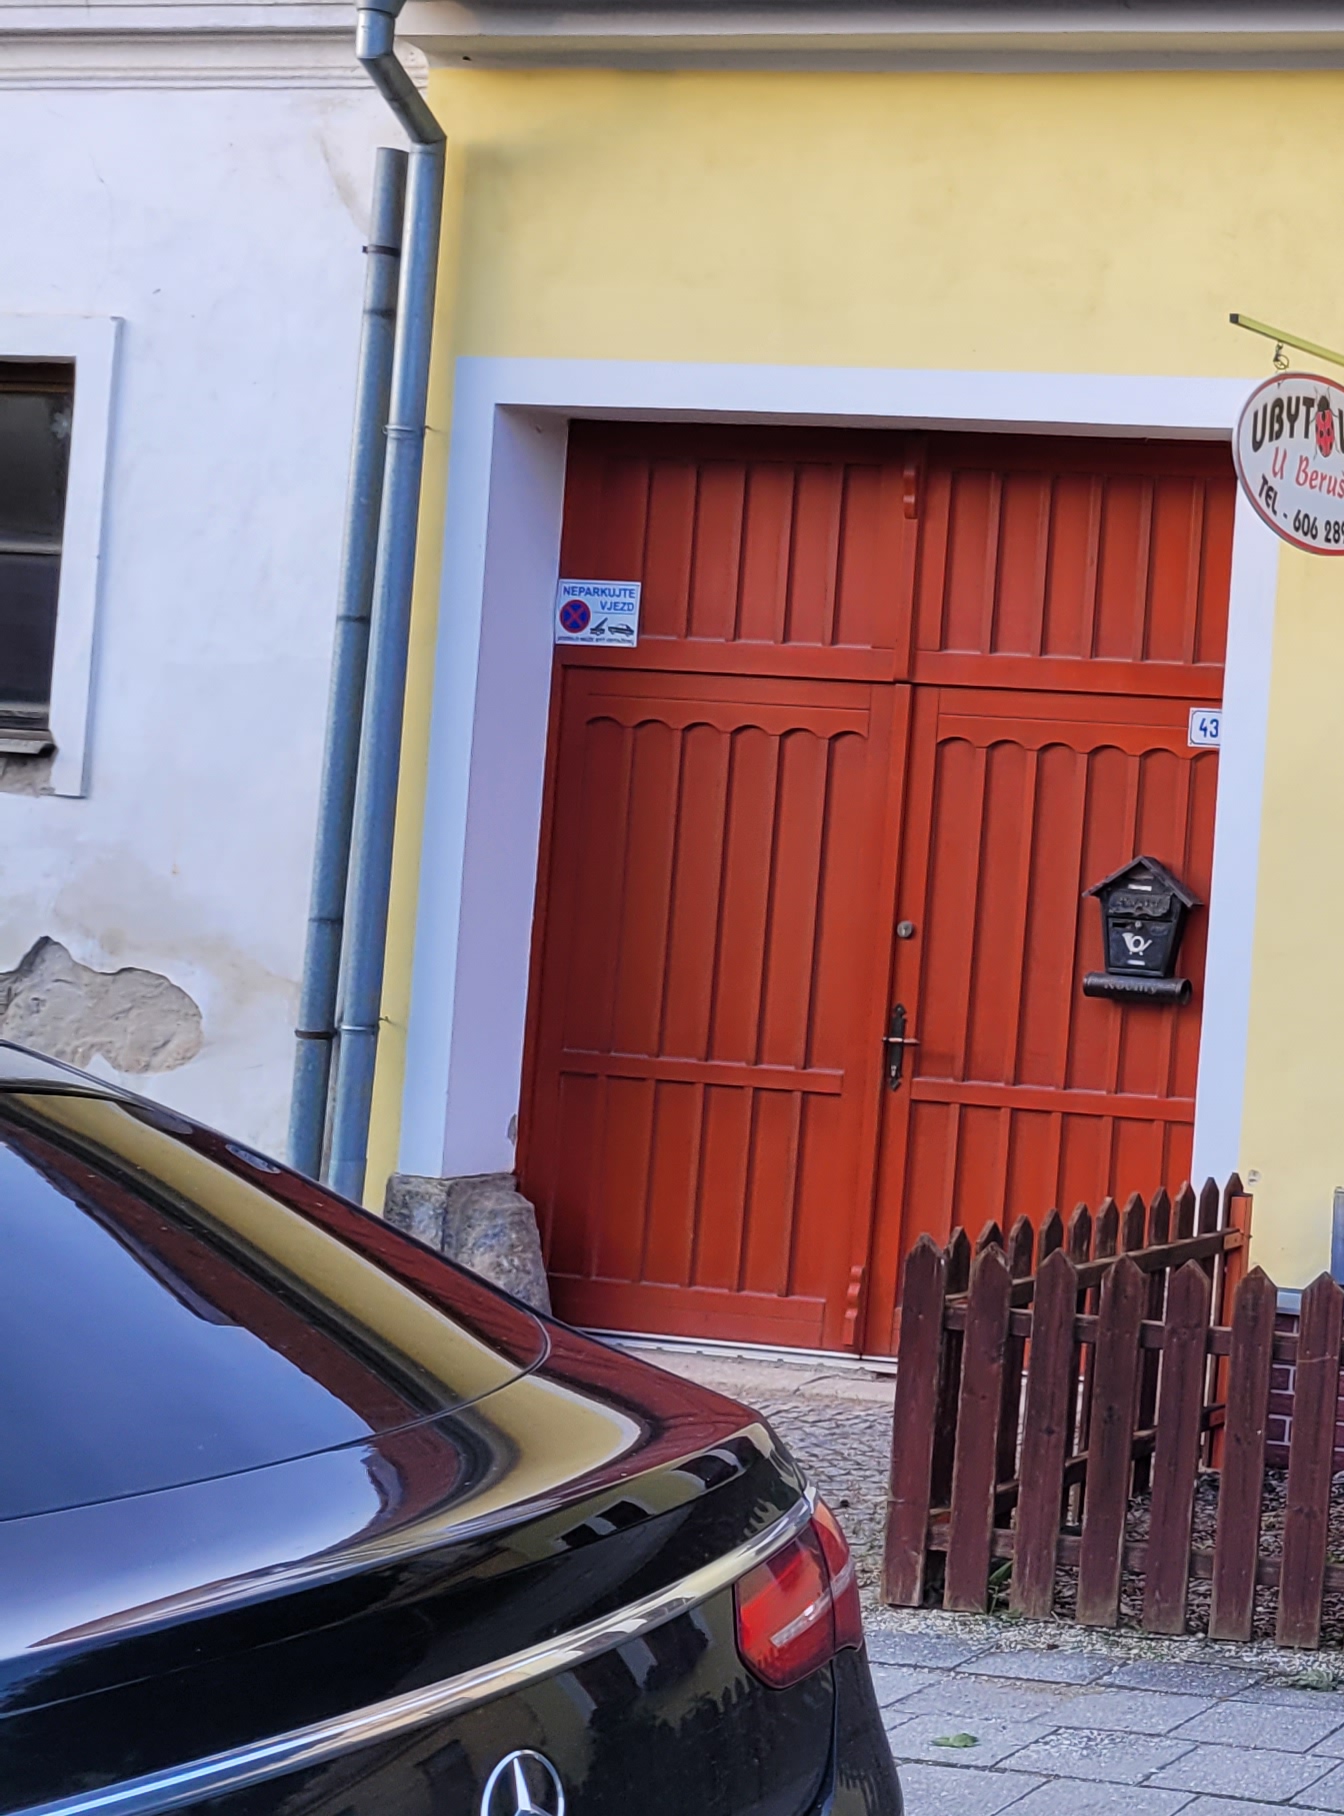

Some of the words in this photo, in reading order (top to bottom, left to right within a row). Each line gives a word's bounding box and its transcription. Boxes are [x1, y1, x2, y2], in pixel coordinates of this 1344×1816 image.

[1272, 446, 1288, 480] U
[1293, 509, 1319, 540] 606
[563, 585, 636, 599] NEPARKUJTE
[600, 600, 635, 612] VJEZD
[1199, 718, 1219, 738] 43
